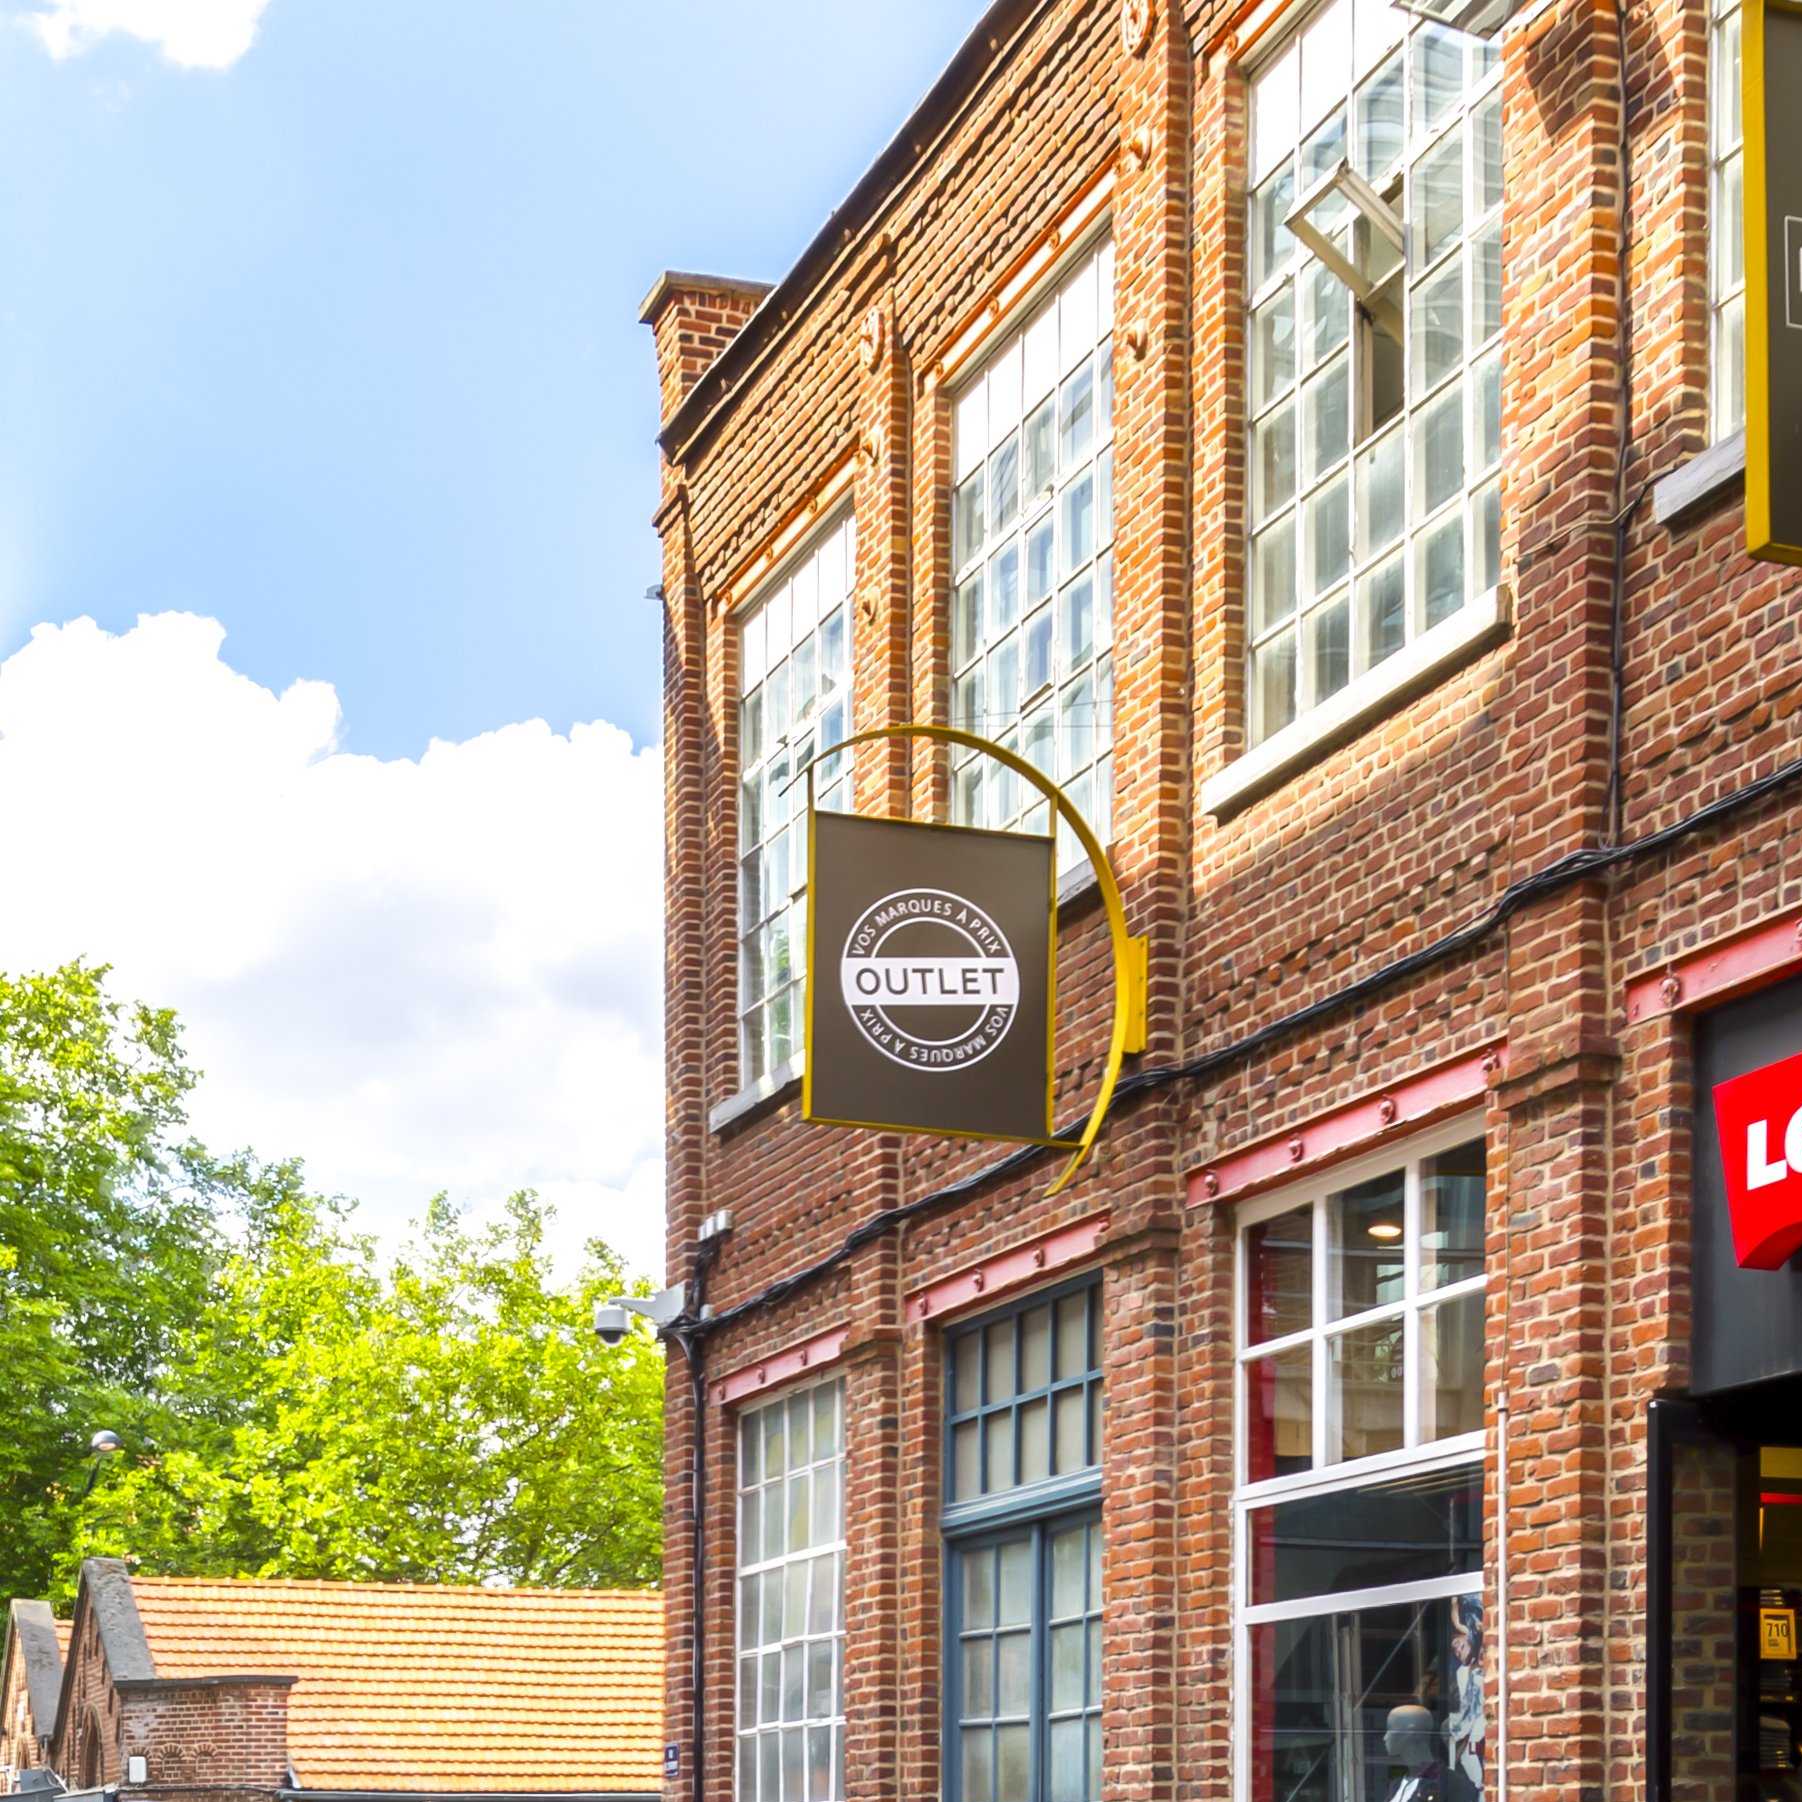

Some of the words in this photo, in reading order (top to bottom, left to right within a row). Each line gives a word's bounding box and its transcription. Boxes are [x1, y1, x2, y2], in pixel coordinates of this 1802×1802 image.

[852, 924, 876, 955] VOS
[875, 899, 952, 927] MARQUES
[969, 918, 1001, 953] PRIX
[856, 968, 1004, 995] OUTLET
[860, 1009, 893, 1043] PRIX
[986, 1007, 1009, 1036] VOS
[909, 1035, 987, 1063] MARQUES
[1766, 1623, 1789, 1638] 710
